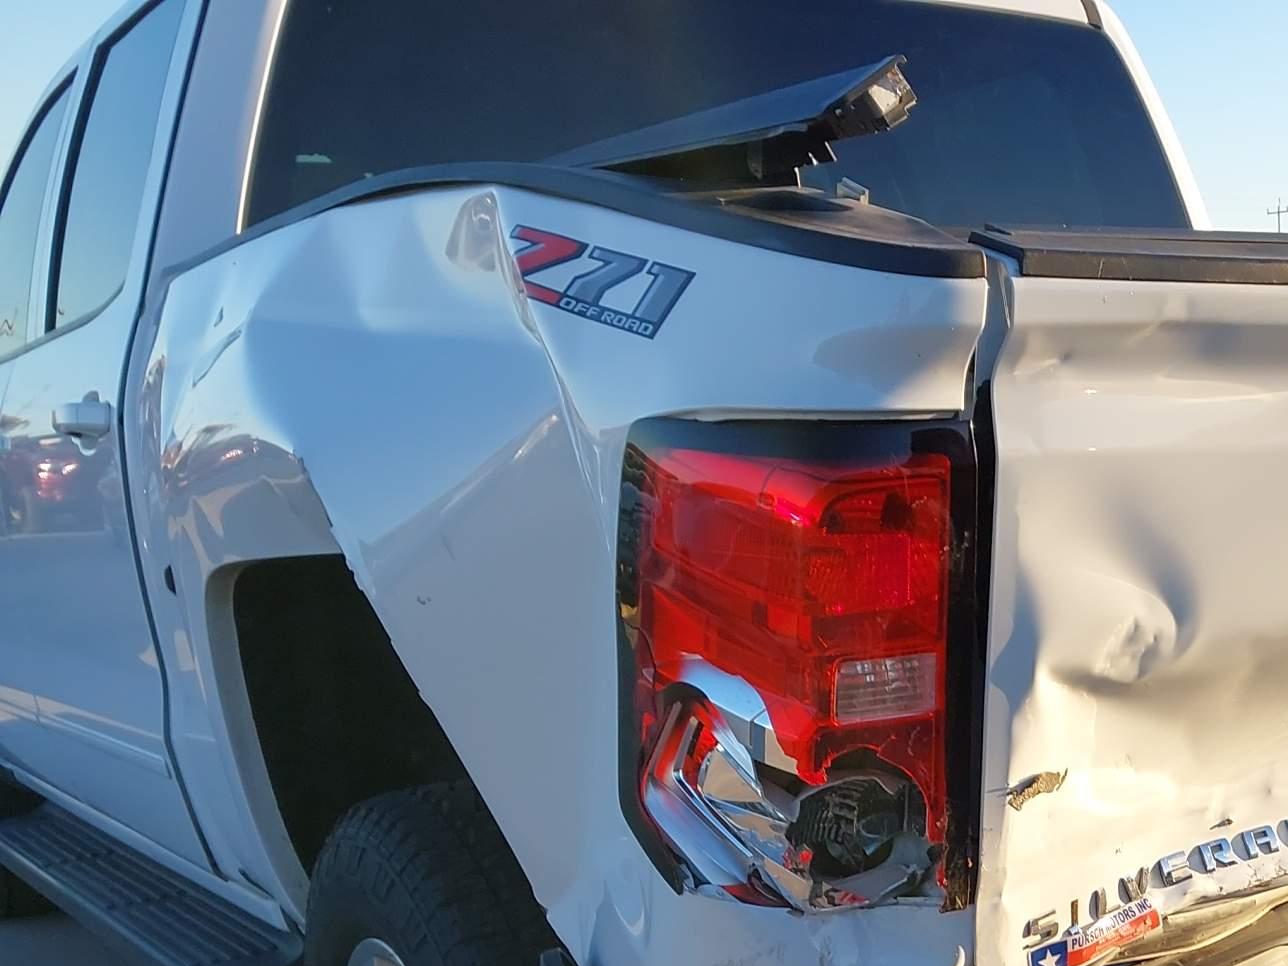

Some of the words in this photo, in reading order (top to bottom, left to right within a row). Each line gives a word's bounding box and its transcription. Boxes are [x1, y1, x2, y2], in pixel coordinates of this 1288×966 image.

[510, 223, 697, 323] Z71
[559, 298, 600, 318] OFF
[601, 310, 654, 336] ROAD
[1135, 897, 1153, 915] INC
